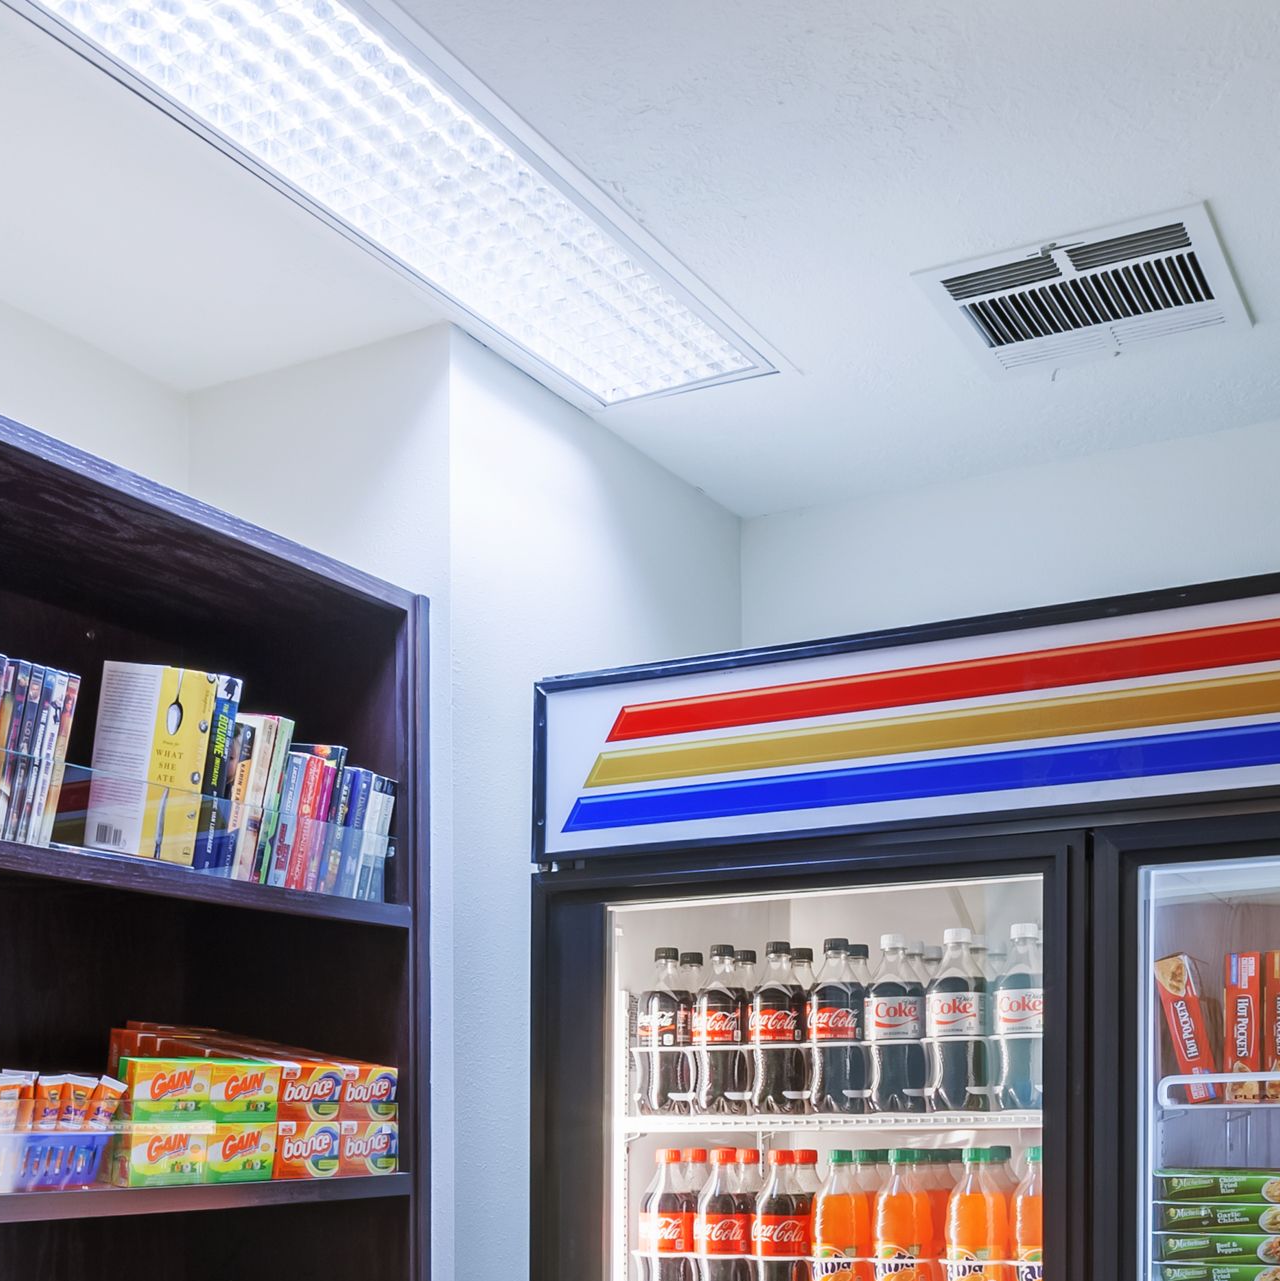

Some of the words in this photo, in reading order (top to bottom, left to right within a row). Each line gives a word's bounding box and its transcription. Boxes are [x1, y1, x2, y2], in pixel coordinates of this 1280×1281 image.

[214, 713, 230, 758] BOURNE
[156, 749, 184, 760] WHAT
[158, 762, 177, 772] SHE
[157, 775, 176, 784] ATE
[875, 1001, 918, 1019] Coke
[931, 998, 974, 1015] Coke
[150, 1068, 194, 1100] GAIN
[224, 1071, 266, 1101] GAIN
[284, 1079, 333, 1105] bounce
[344, 1079, 391, 1104] bounce
[147, 1134, 190, 1165] GAIN
[221, 1130, 263, 1160] GAIN
[283, 1134, 332, 1161] bounce
[344, 1133, 390, 1160] bounce
